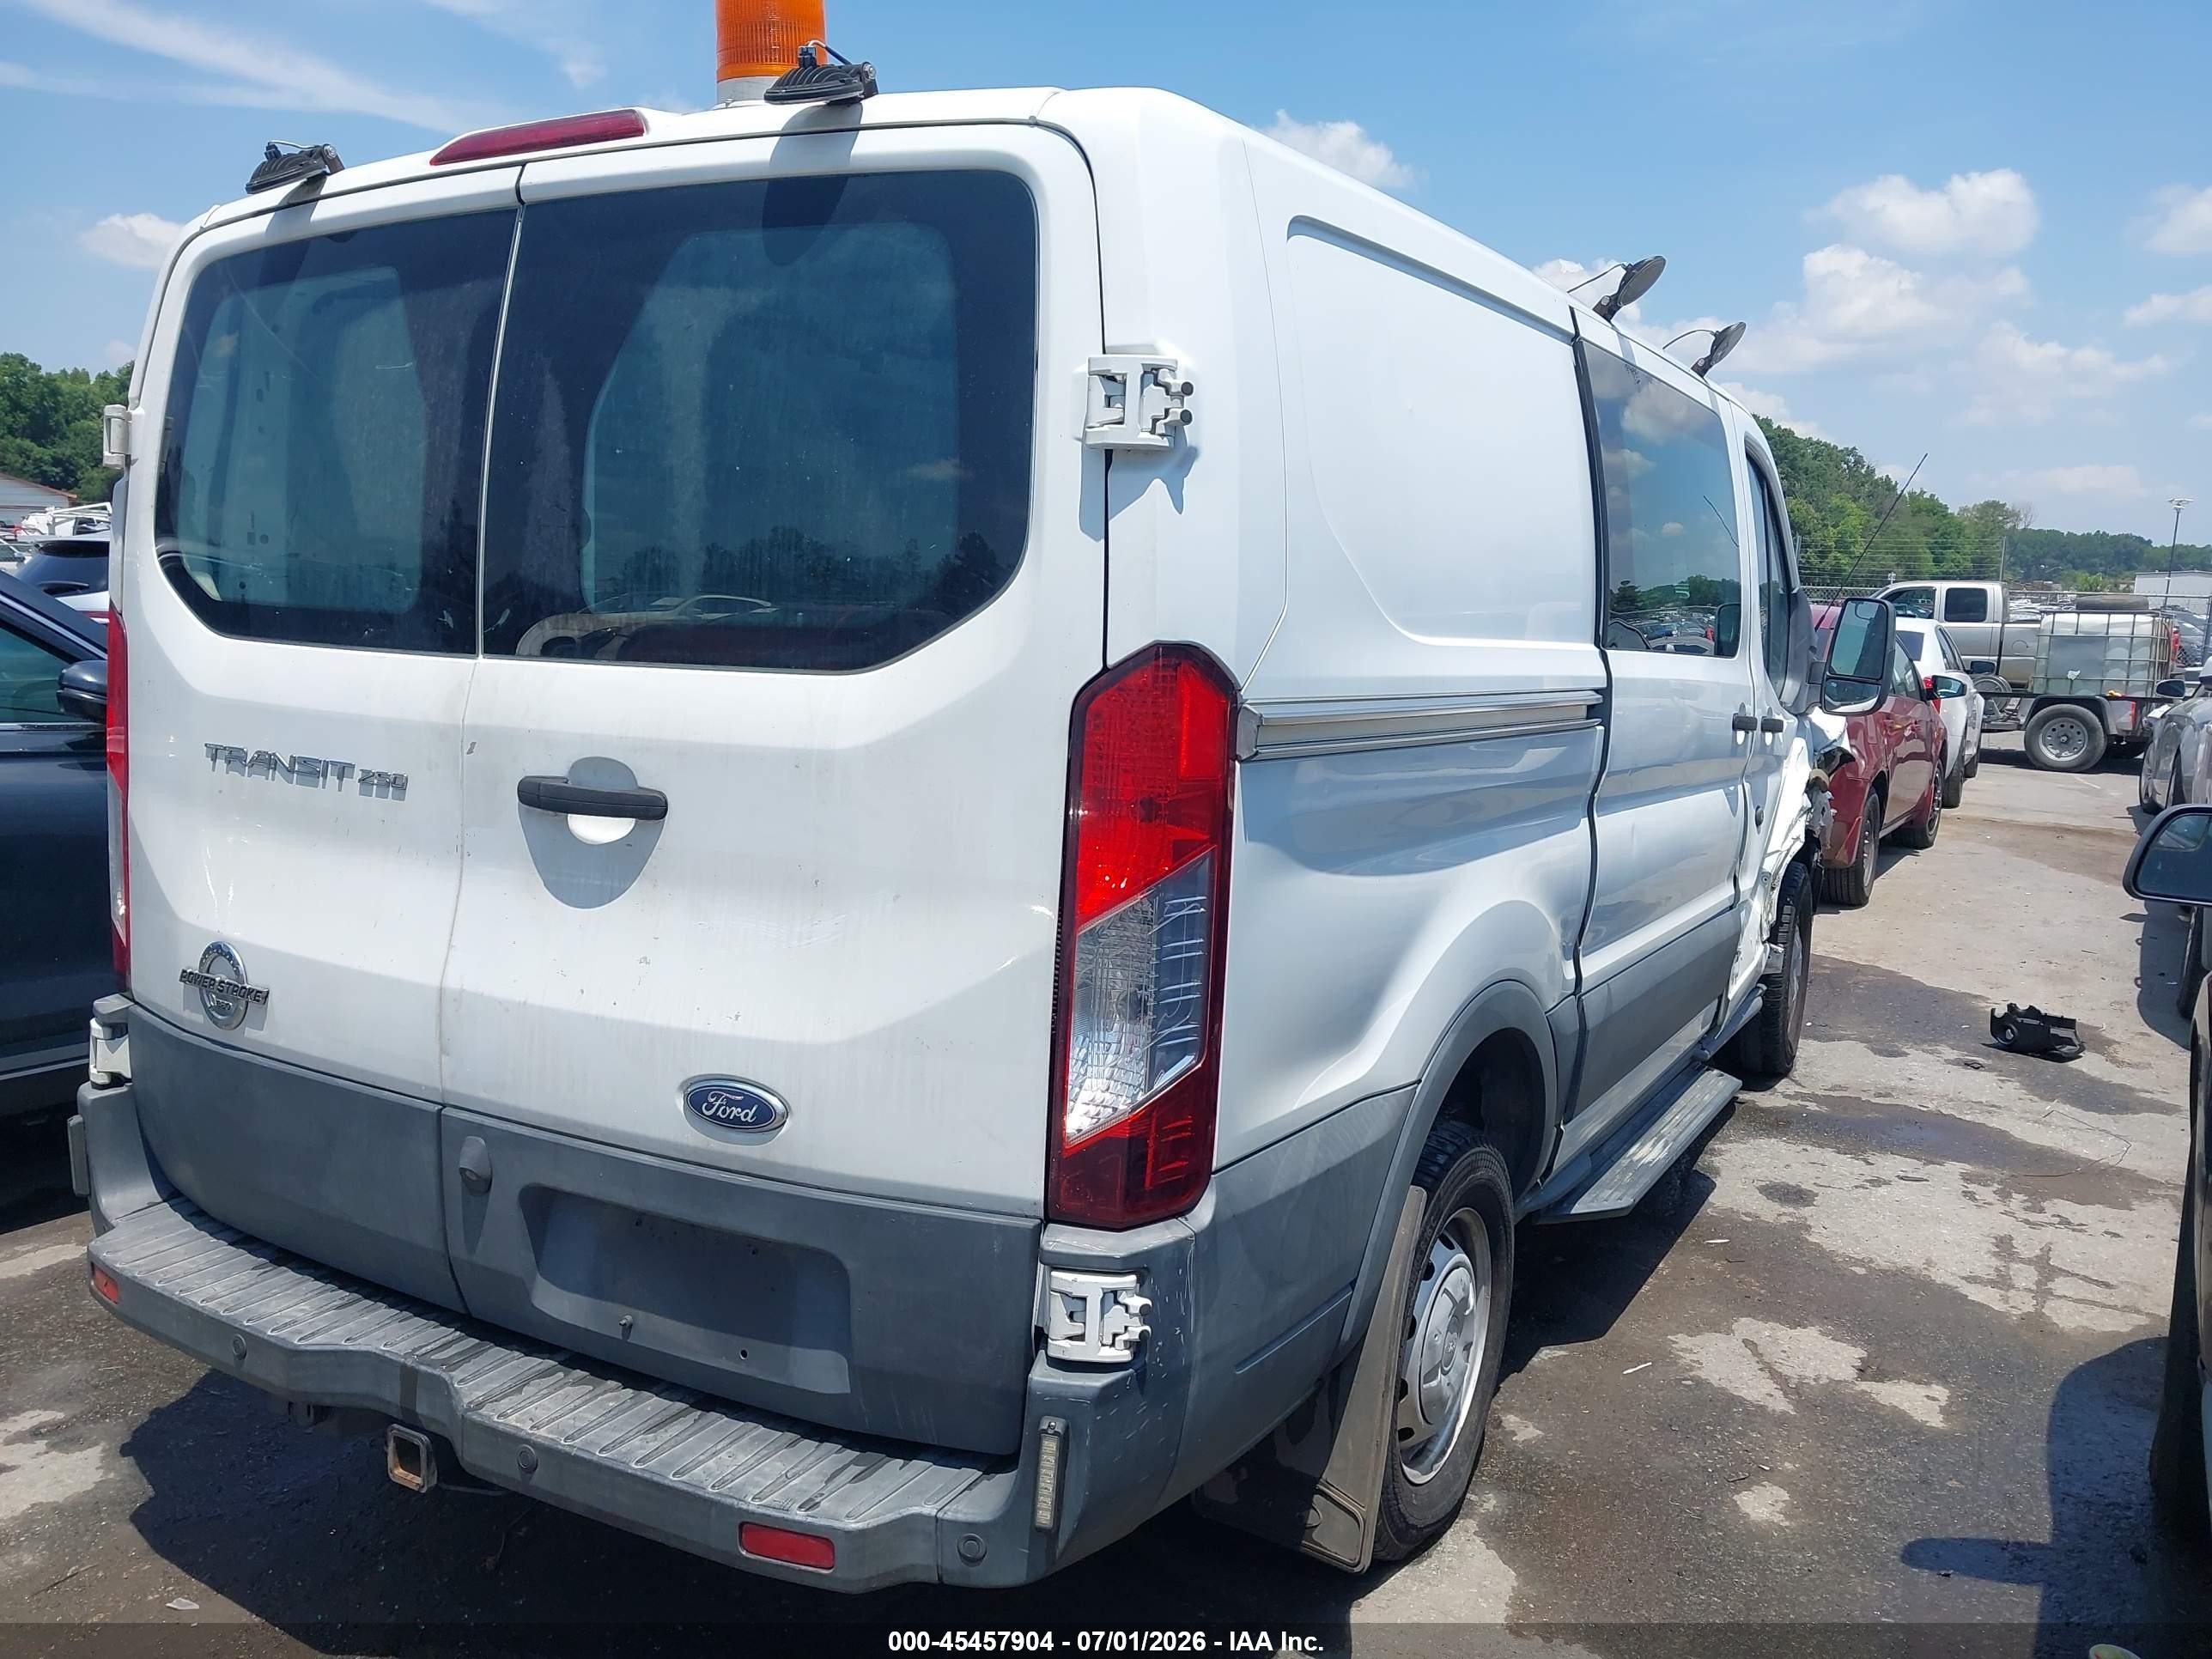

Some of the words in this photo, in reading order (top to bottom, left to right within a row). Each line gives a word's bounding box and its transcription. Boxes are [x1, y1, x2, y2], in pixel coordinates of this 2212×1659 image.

[204, 743, 356, 778] TRANSIT
[357, 769, 409, 791] 250
[702, 1091, 757, 1123] Ford
